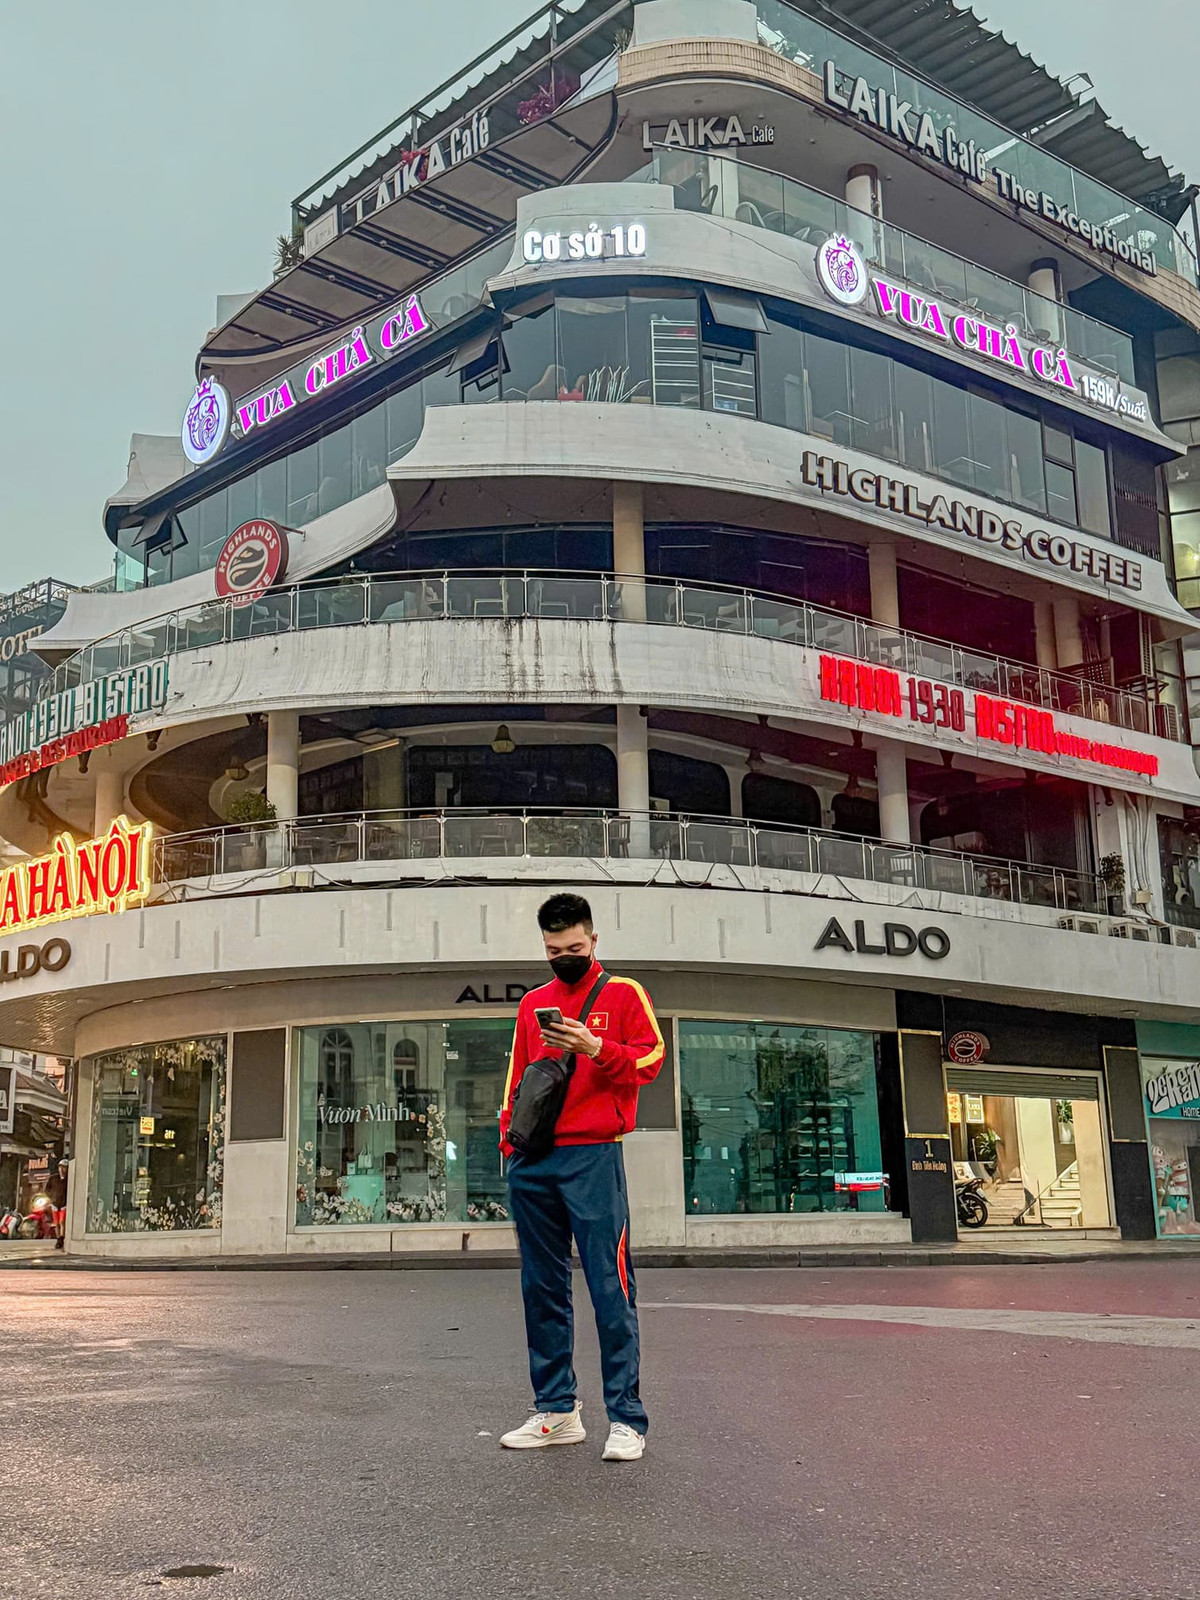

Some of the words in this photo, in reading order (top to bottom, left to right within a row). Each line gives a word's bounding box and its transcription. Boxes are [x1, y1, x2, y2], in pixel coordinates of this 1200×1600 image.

[643, 115, 747, 150] LAIKA
[751, 121, 775, 144] Café
[356, 144, 447, 221] LAIKA
[450, 108, 491, 168] Café
[823, 59, 941, 159] LAIKA
[943, 124, 988, 183] Café
[992, 166, 1040, 212] The
[1039, 190, 1158, 277] Exceptional
[522, 229, 562, 262] Cơ
[566, 222, 605, 260] sở
[607, 222, 647, 259] 10
[872, 277, 949, 340] VUA
[952, 315, 1027, 371] CHẢ
[1030, 347, 1078, 391] CÁ
[236, 378, 297, 434] VUA
[304, 324, 373, 396] CHẢ
[379, 293, 430, 350] CÁ
[801, 450, 1024, 550] HIGHLANDS
[1025, 528, 1143, 592] COFFEE
[218, 524, 277, 574] HIGHLANDS
[0, 710, 31, 766] ANOI
[32, 688, 76, 748] 1930
[83, 659, 170, 727] BISTRO
[818, 653, 903, 717] HANOI
[906, 677, 966, 733] 1930
[973, 692, 1057, 756] BISTRO
[41, 713, 129, 768] RESTAURANT
[0, 936, 72, 983] LDO
[813, 916, 951, 960] ALDO
[455, 982, 542, 1004] ALD
[364, 1101, 410, 1122] Mình
[924, 1139, 934, 1158] 1
